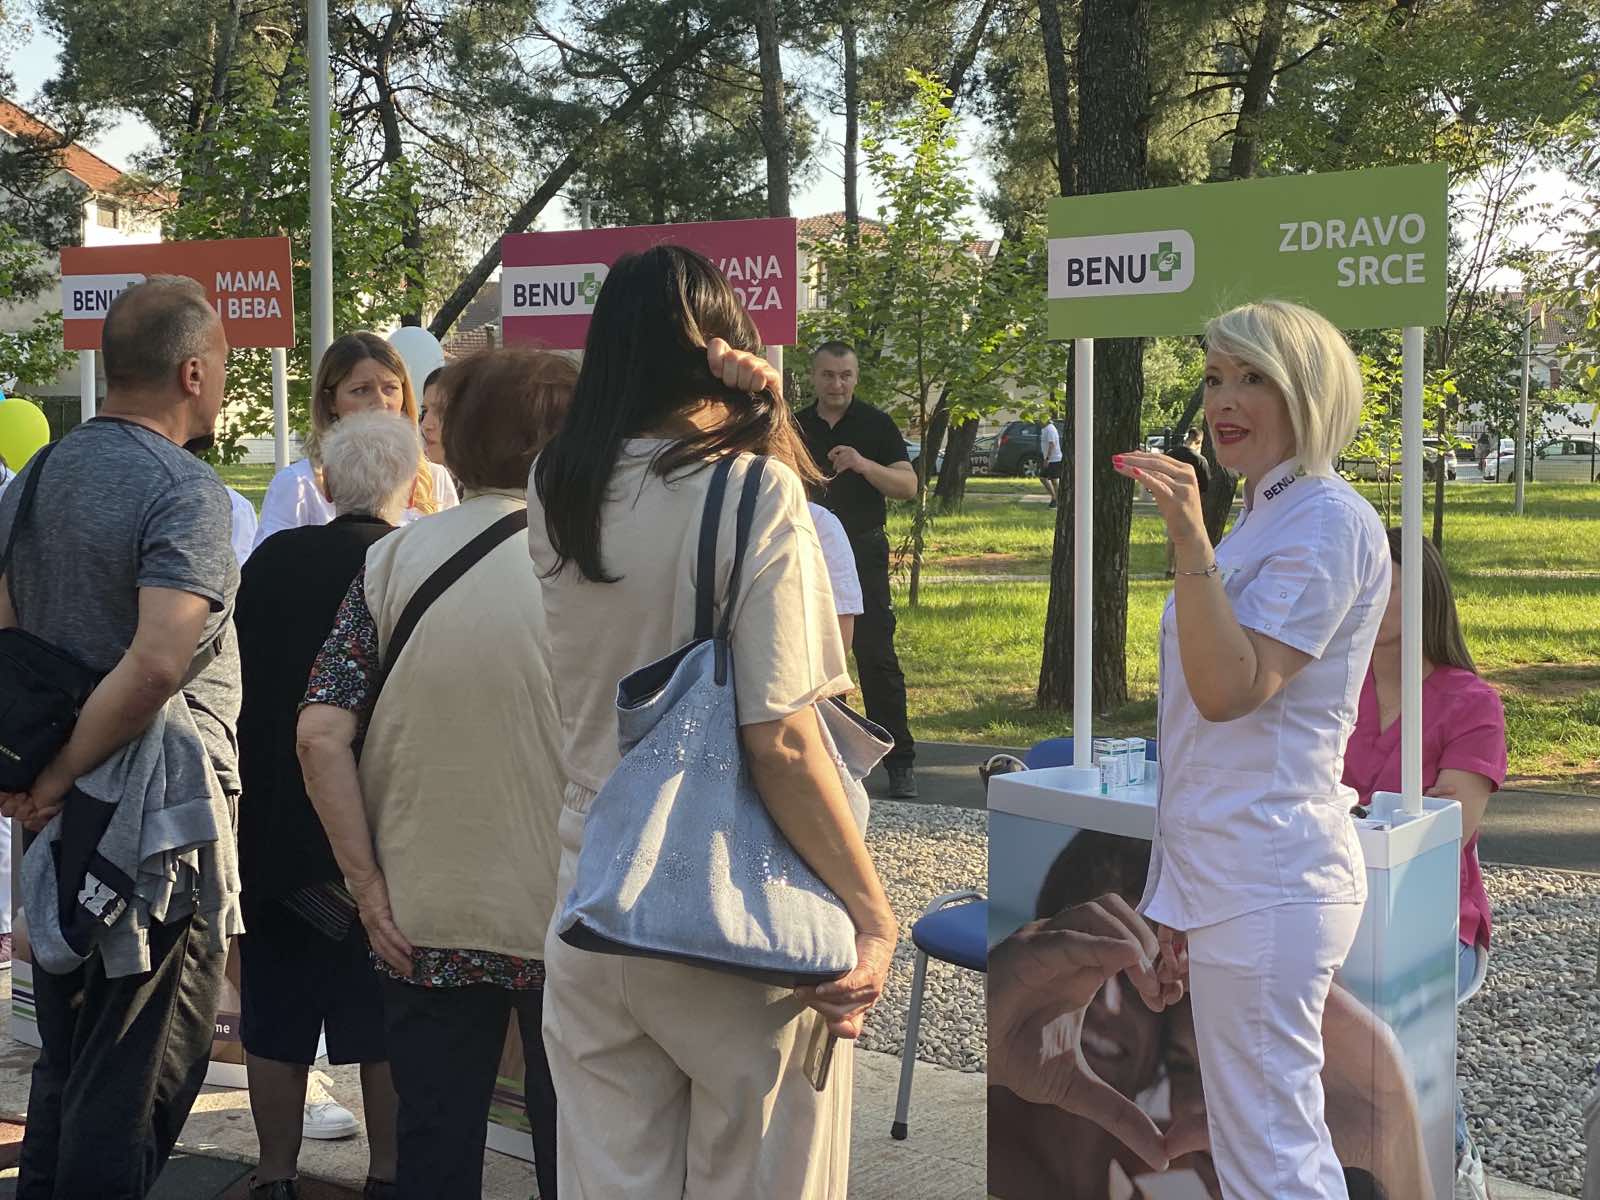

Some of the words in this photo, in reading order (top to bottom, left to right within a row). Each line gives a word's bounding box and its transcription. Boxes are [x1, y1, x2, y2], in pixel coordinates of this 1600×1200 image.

[1279, 213, 1426, 252] ZDRAVO
[215, 270, 281, 293] MAMA
[1067, 254, 1147, 287] BENU
[1337, 253, 1426, 288] SRCE
[513, 281, 576, 308] BENU
[227, 297, 282, 320] BEBA
[1263, 475, 1296, 501] BENU
